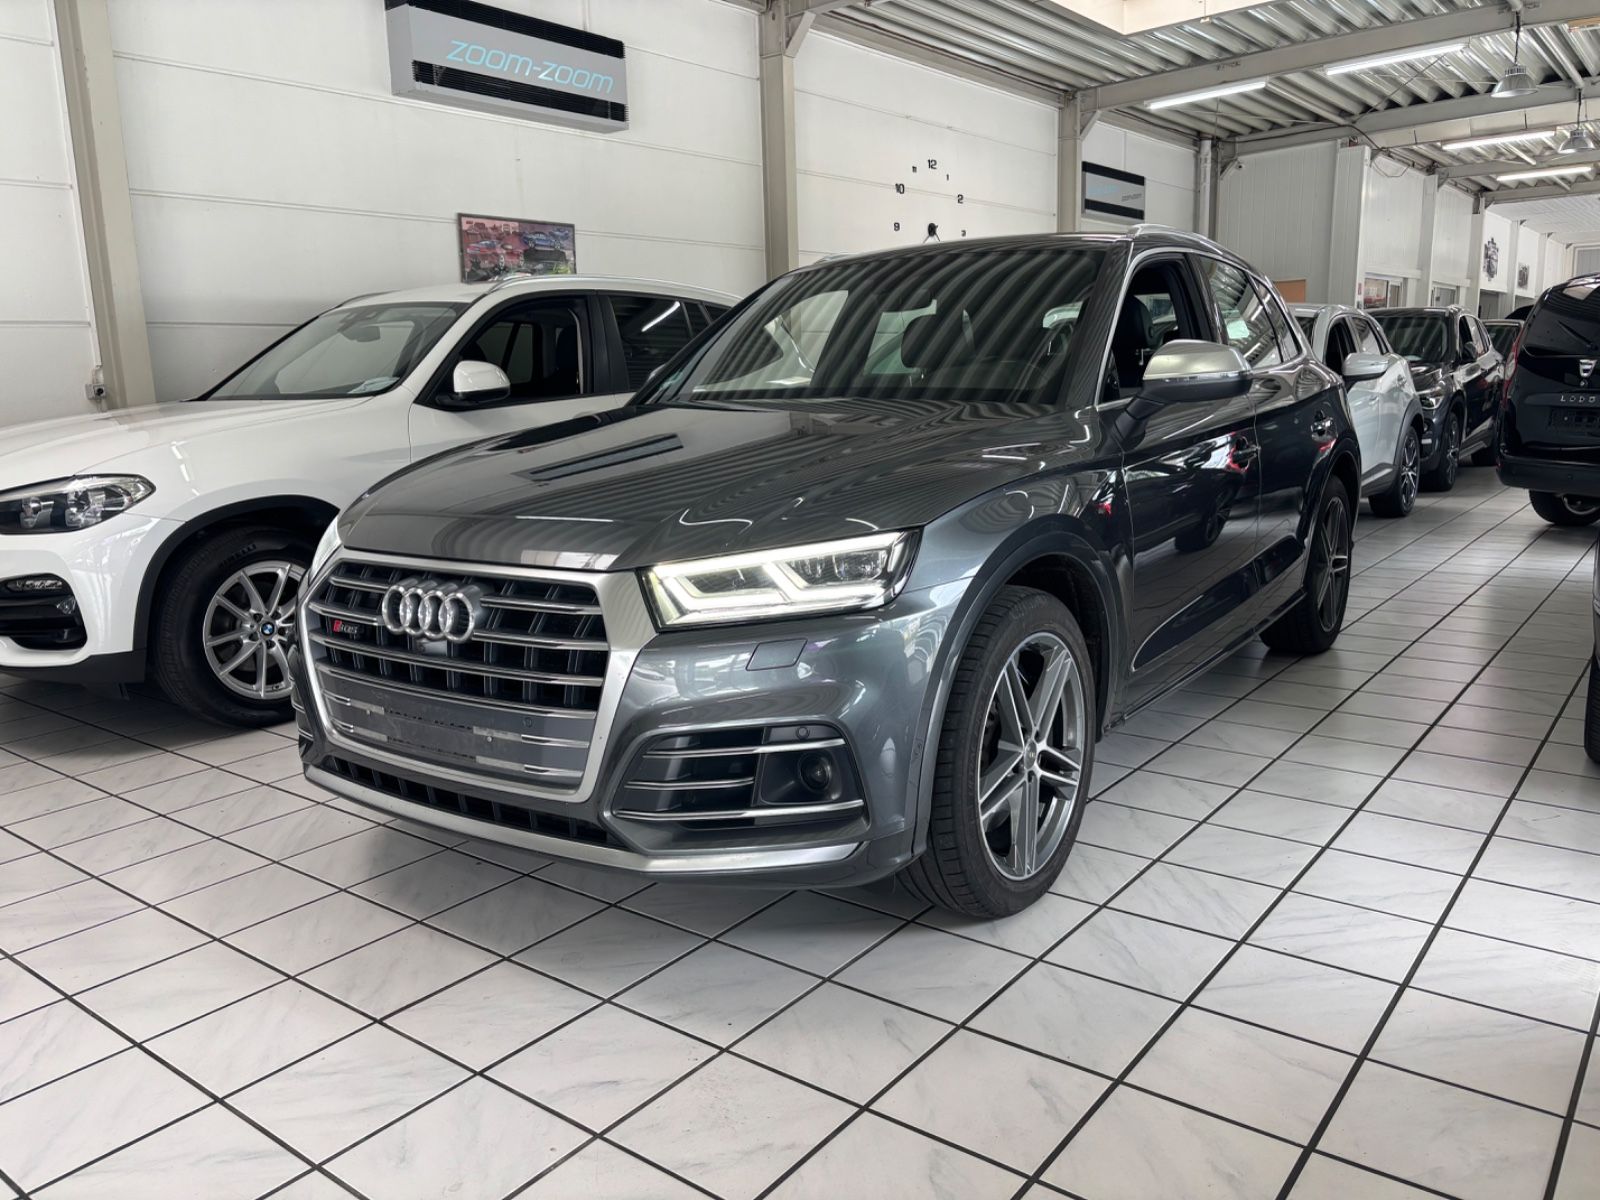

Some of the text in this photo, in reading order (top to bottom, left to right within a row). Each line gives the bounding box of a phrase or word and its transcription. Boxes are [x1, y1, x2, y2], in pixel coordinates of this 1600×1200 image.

[446, 39, 614, 94] zoom-zoom
[927, 159, 937, 170] 12
[895, 183, 905, 194] 10
[957, 194, 964, 204] 2
[893, 222, 900, 231] 9
